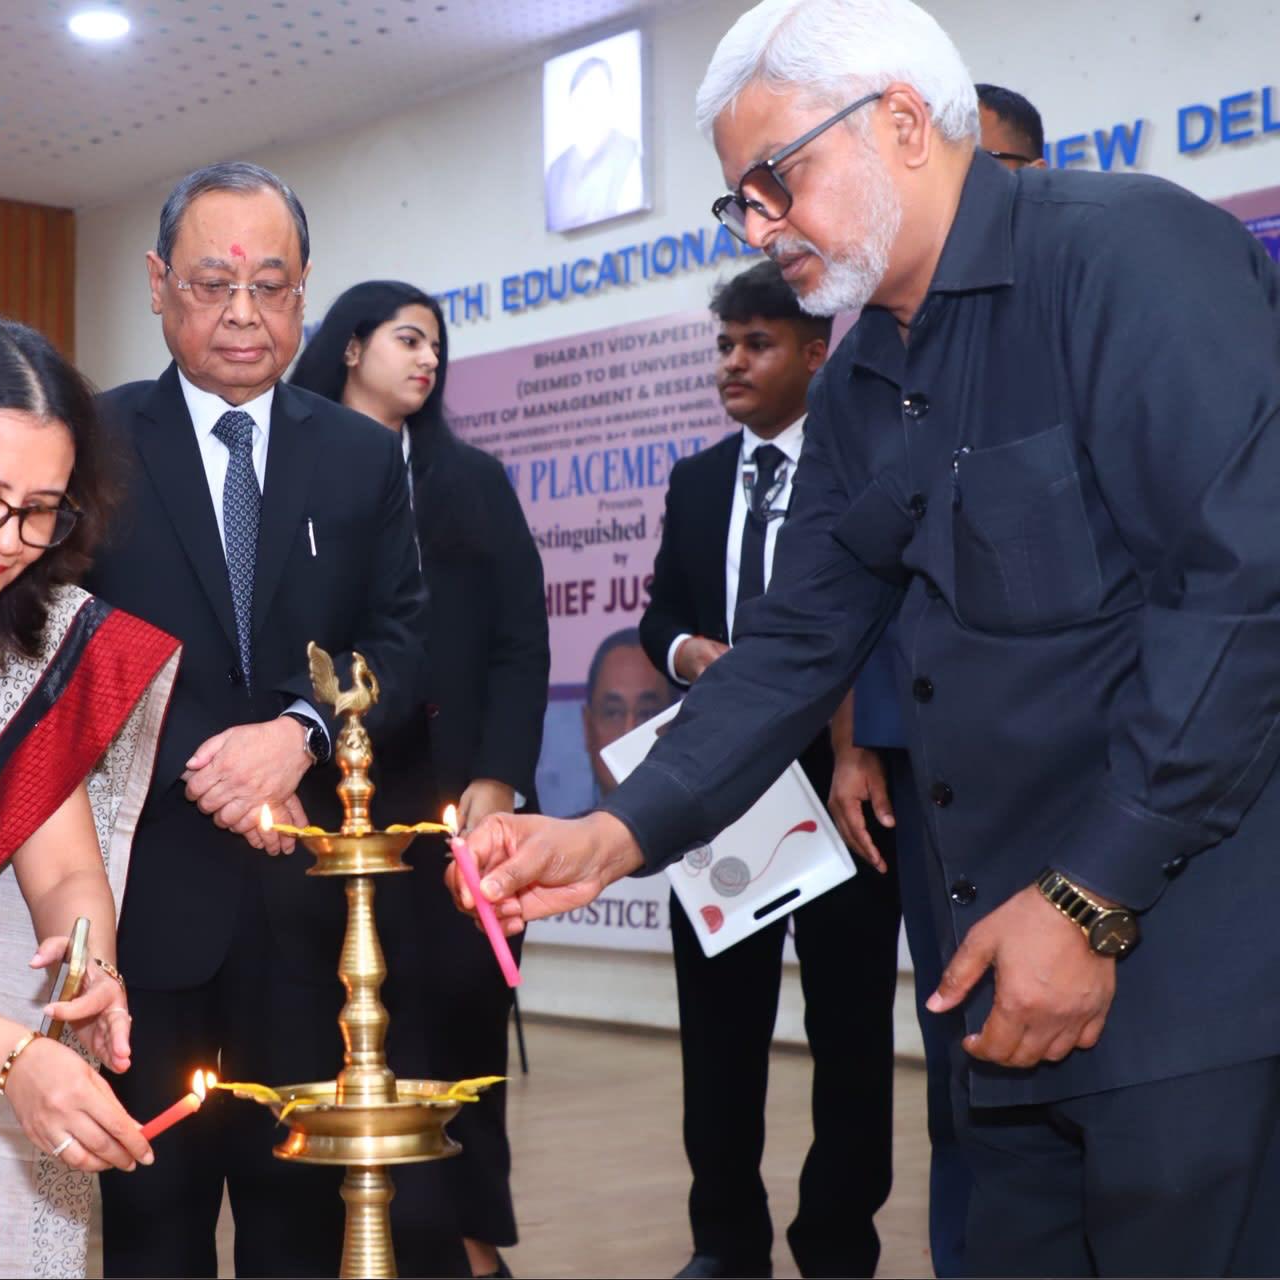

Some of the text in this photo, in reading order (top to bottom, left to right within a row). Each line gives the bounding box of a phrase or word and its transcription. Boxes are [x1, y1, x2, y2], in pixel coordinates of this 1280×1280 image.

[533, 321, 714, 369] BHARATI VIDYAPEETH
[516, 371, 582, 399] (DEEMED
[585, 367, 605, 384] TO
[609, 363, 626, 379] BE
[500, 406, 518, 423] OF
[523, 387, 633, 418] MANAGEMENT
[637, 384, 649, 399] &
